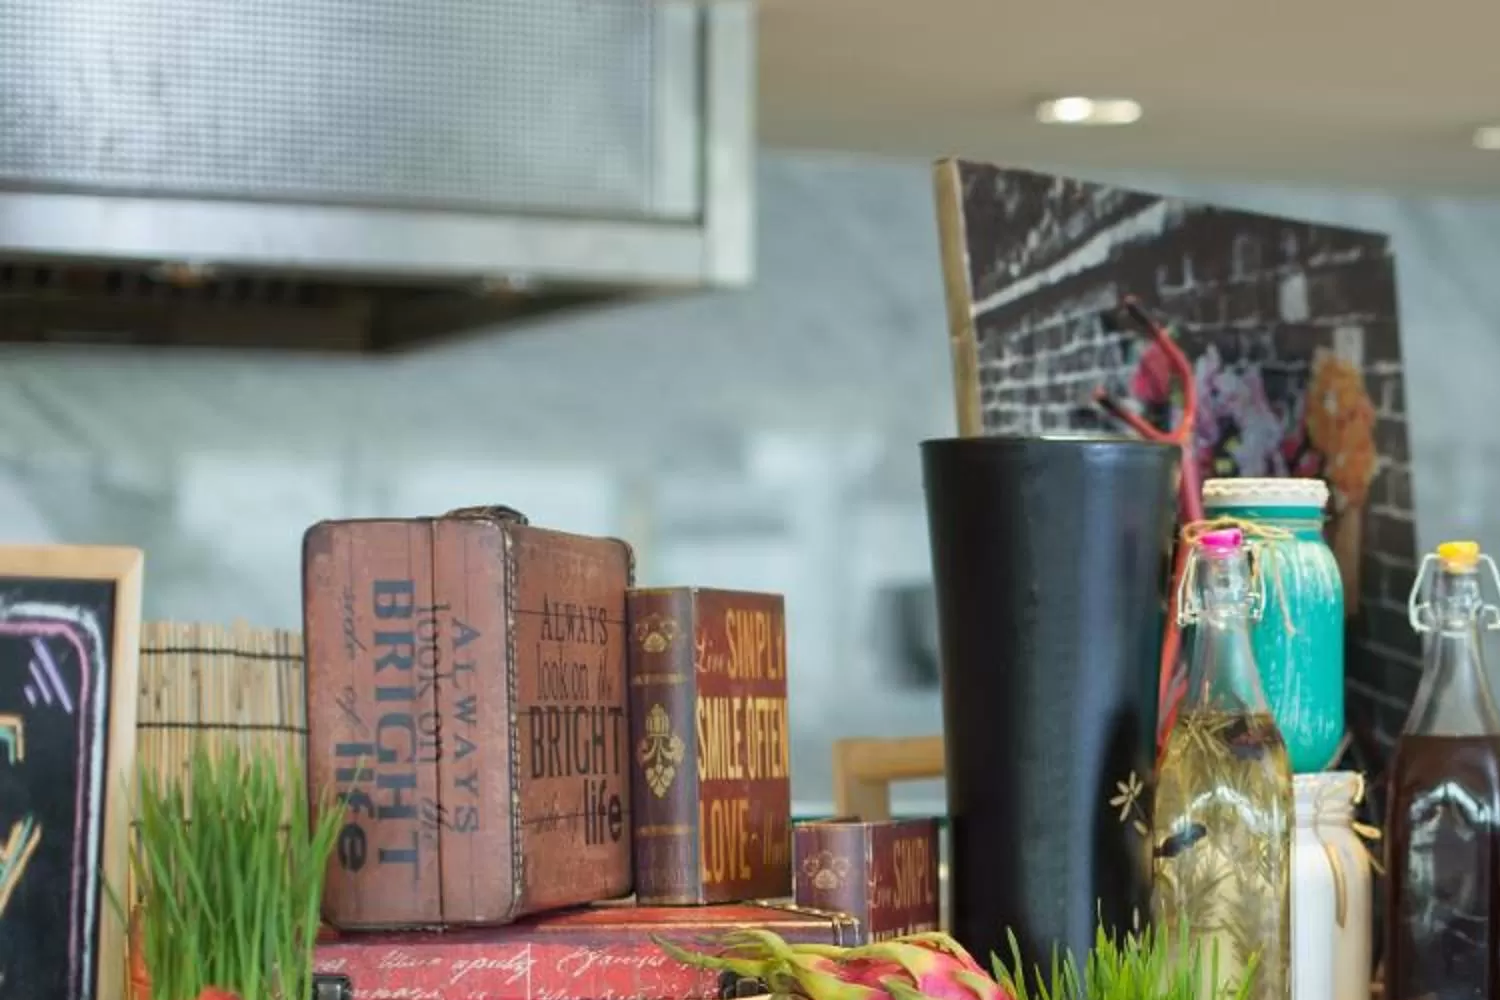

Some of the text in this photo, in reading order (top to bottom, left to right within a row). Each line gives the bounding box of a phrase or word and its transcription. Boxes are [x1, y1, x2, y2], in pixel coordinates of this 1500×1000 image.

[417, 602, 452, 700] look
[540, 593, 609, 647] ALWAYS
[536, 643, 569, 702] look
[372, 579, 420, 890] BRIGHT
[419, 711, 446, 764] on
[452, 616, 483, 834] ALWAYS
[528, 705, 625, 779] BRIGHT
[696, 694, 790, 781] SMILE OFTEN
[334, 741, 376, 873] life
[583, 778, 623, 845] life
[701, 797, 752, 884] LOVE
